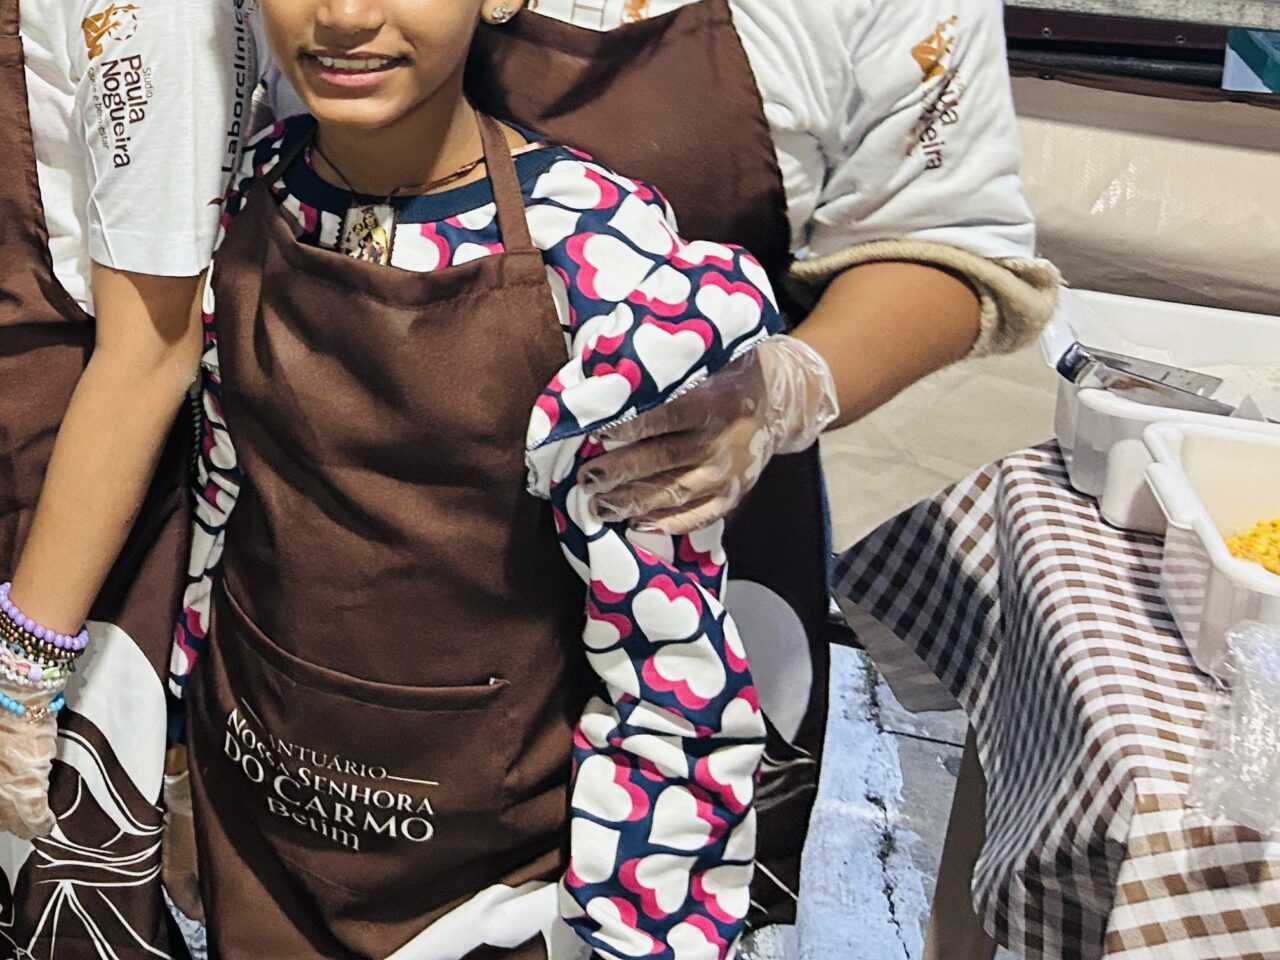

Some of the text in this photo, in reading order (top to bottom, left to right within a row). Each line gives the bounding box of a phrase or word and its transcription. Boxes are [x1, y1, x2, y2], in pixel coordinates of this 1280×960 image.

[101, 59, 131, 169] Nogueira
[121, 54, 148, 124] Paula
[142, 66, 153, 99] Studio
[224, 730, 435, 842] DO CARMO
[227, 708, 435, 816] NOSSA SENHORA
[269, 734, 388, 780] ANTUÁRIO
[267, 796, 360, 851] Betim
